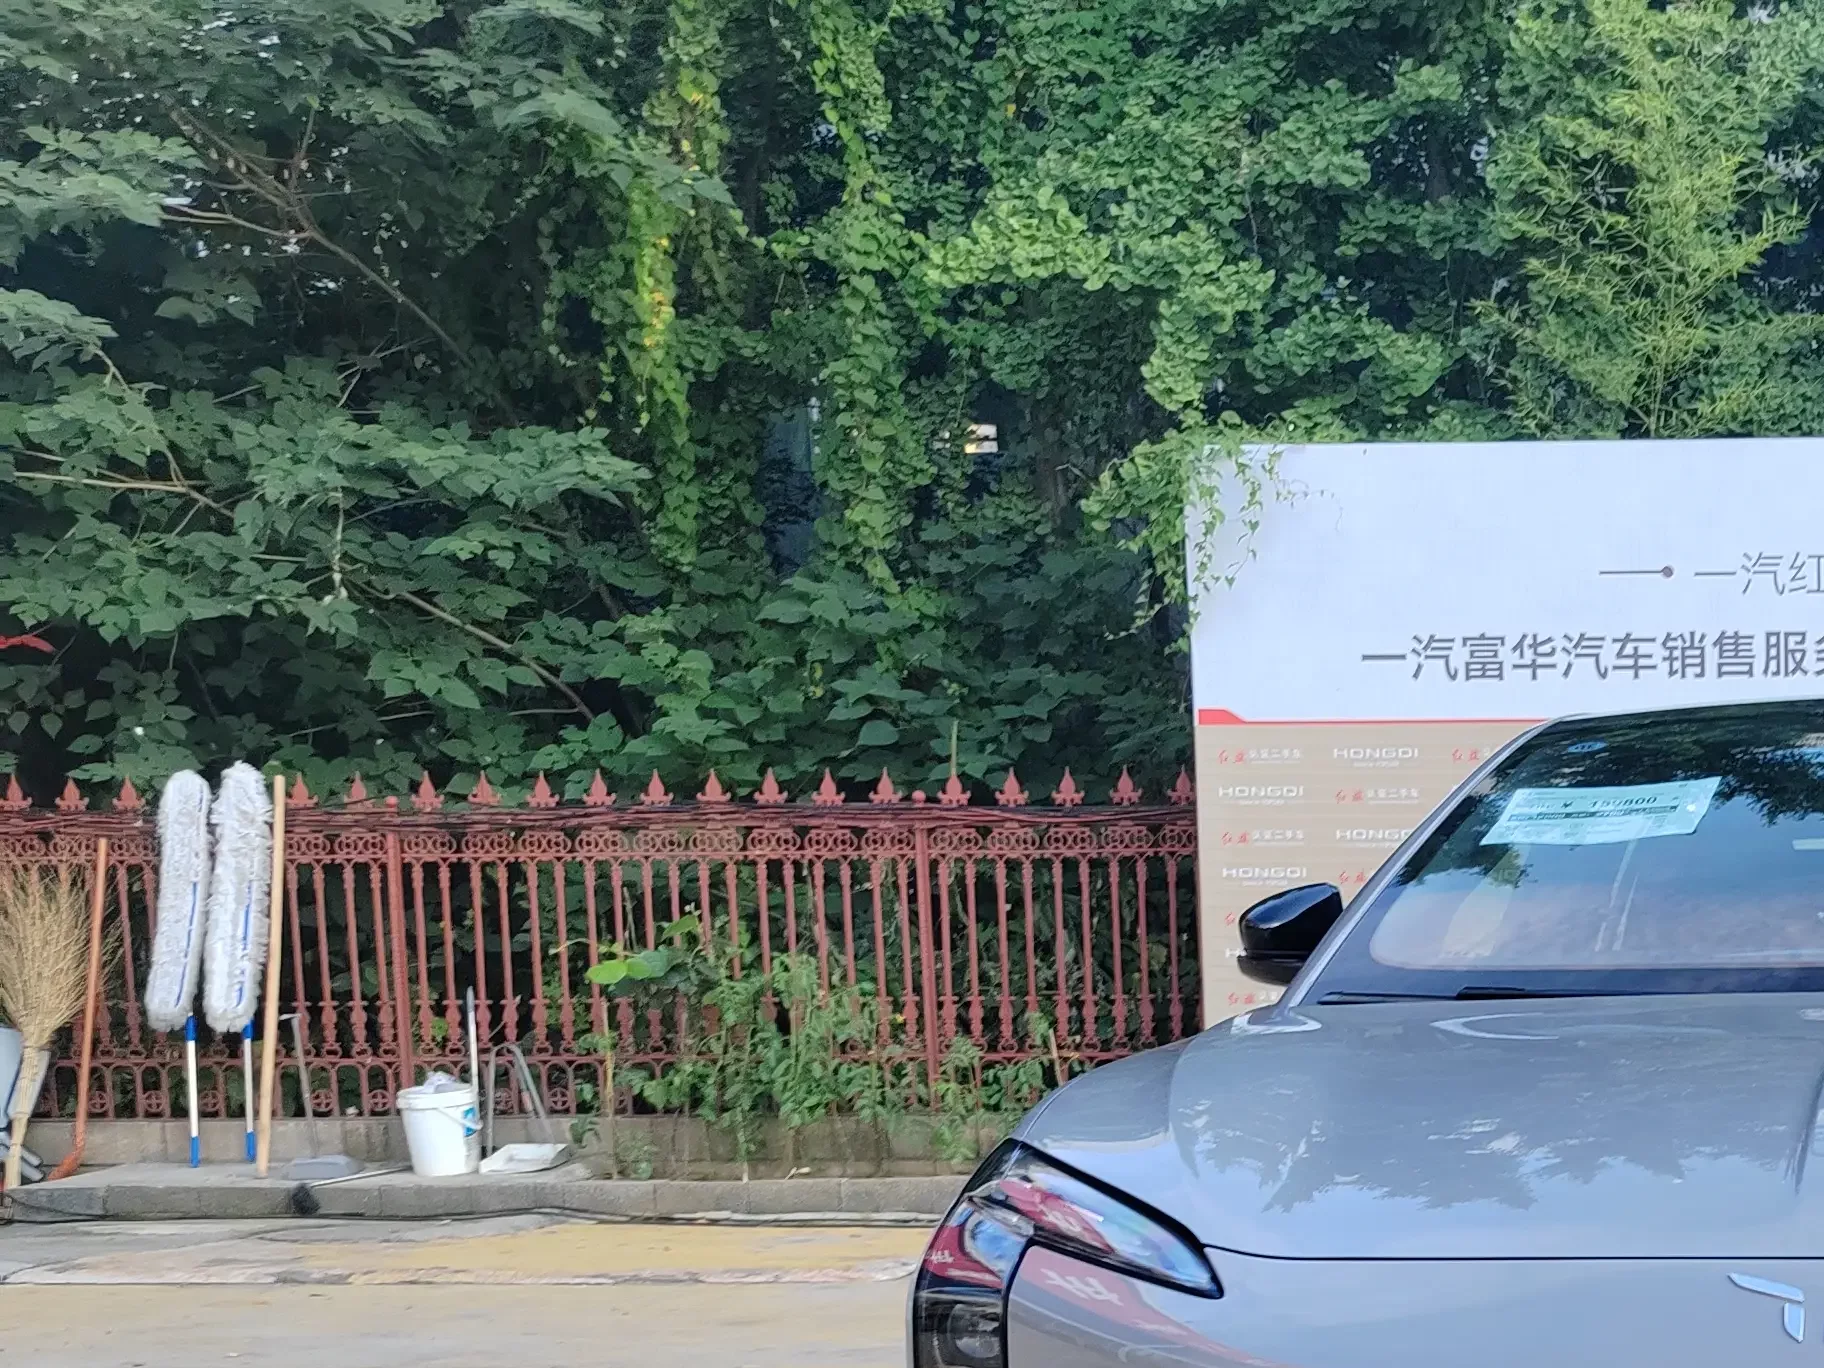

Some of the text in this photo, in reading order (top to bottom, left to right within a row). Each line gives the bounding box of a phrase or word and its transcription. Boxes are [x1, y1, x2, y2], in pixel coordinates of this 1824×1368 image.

[1332, 747, 1420, 760] HONGQI
[1217, 784, 1305, 798] HONGQI
[1221, 866, 1308, 880] HONGQI
